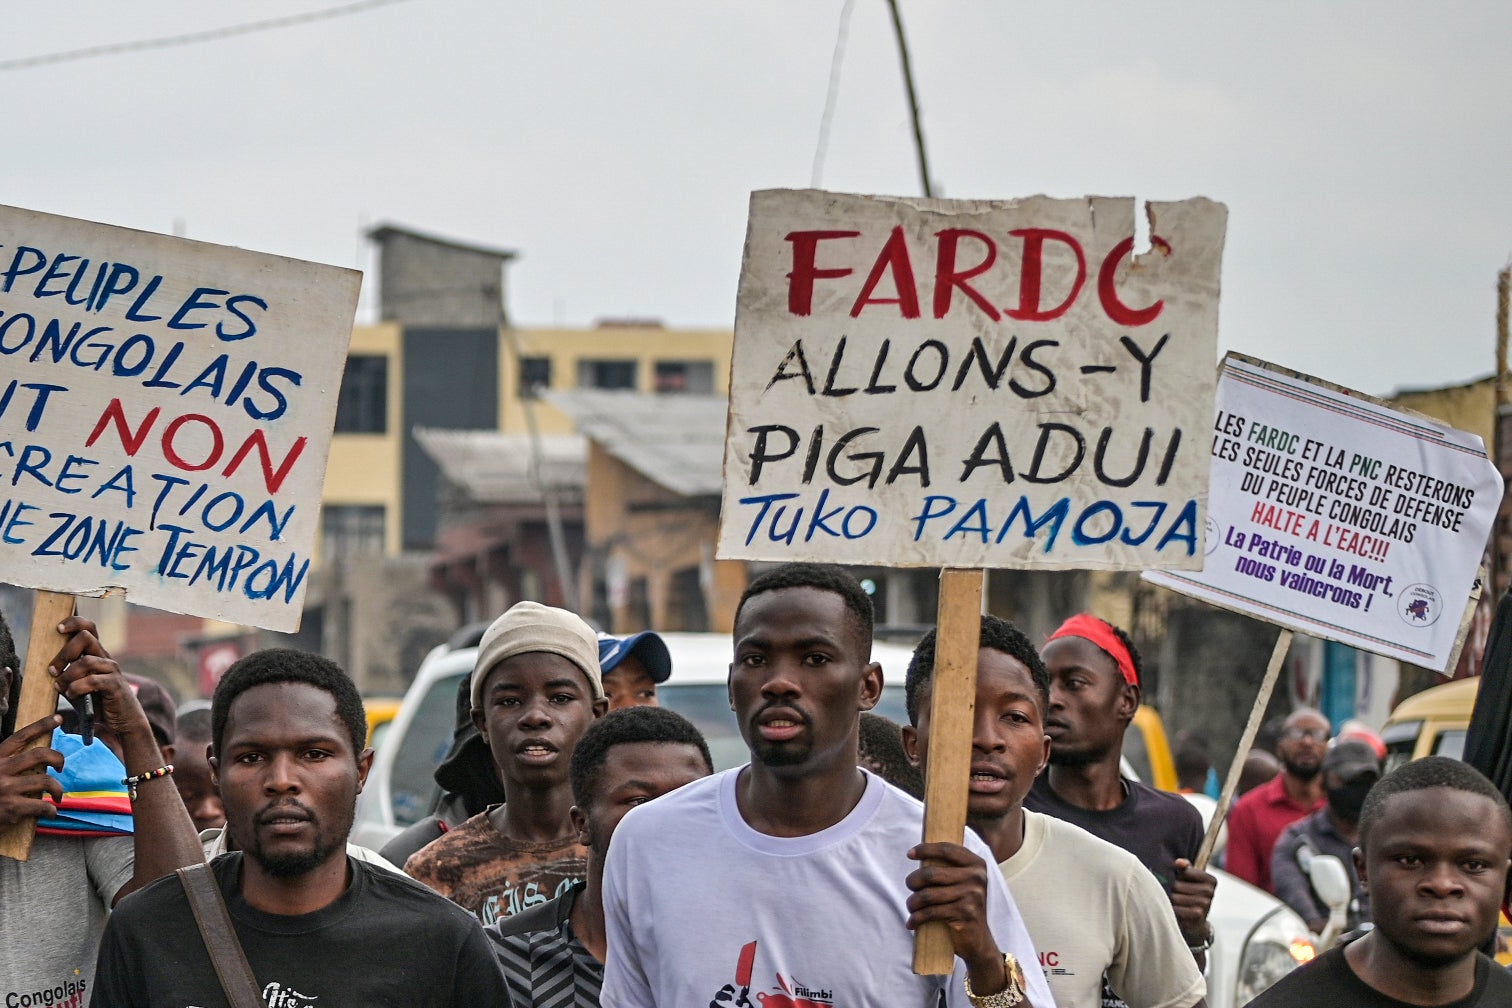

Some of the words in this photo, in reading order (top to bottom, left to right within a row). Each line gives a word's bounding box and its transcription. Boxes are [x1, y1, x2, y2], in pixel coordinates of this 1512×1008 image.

[1, 247, 267, 342] PEUPLES
[783, 225, 1173, 327] FARDC
[85, 399, 308, 496] NON
[746, 423, 930, 489] PIGA
[960, 421, 1183, 488] ADUI
[1211, 435, 1241, 462] LES
[1243, 446, 1304, 482] SEULES
[1305, 466, 1368, 502] FORCES
[1369, 485, 1393, 510] DE
[1393, 493, 1465, 533] DEFENSE
[1214, 410, 1246, 438] LES
[1247, 421, 1300, 455] FARDC
[1301, 439, 1324, 462] ET
[1324, 446, 1346, 470] LA
[1348, 453, 1383, 481] PNC
[1384, 464, 1475, 510] RESTERONS
[912, 495, 1198, 556] PAMOJA
[1240, 472, 1265, 495] DU
[1266, 479, 1327, 516] PEUPLE
[1328, 499, 1417, 544] CONGOLAIS
[1250, 501, 1306, 537] HALTE
[1306, 519, 1320, 542] A
[1323, 523, 1391, 563] L'EAC!!!
[31, 512, 145, 571] ZONE
[155, 523, 310, 604] TEMPON
[1224, 526, 1247, 549] La
[1247, 532, 1303, 567] Patrie
[1304, 554, 1327, 575] ou
[1327, 558, 1346, 581] la
[1347, 564, 1394, 599] Mort,
[1235, 555, 1277, 582] nous
[1279, 569, 1363, 610] vaincrons
[795, 986, 834, 1000] Filimbi
